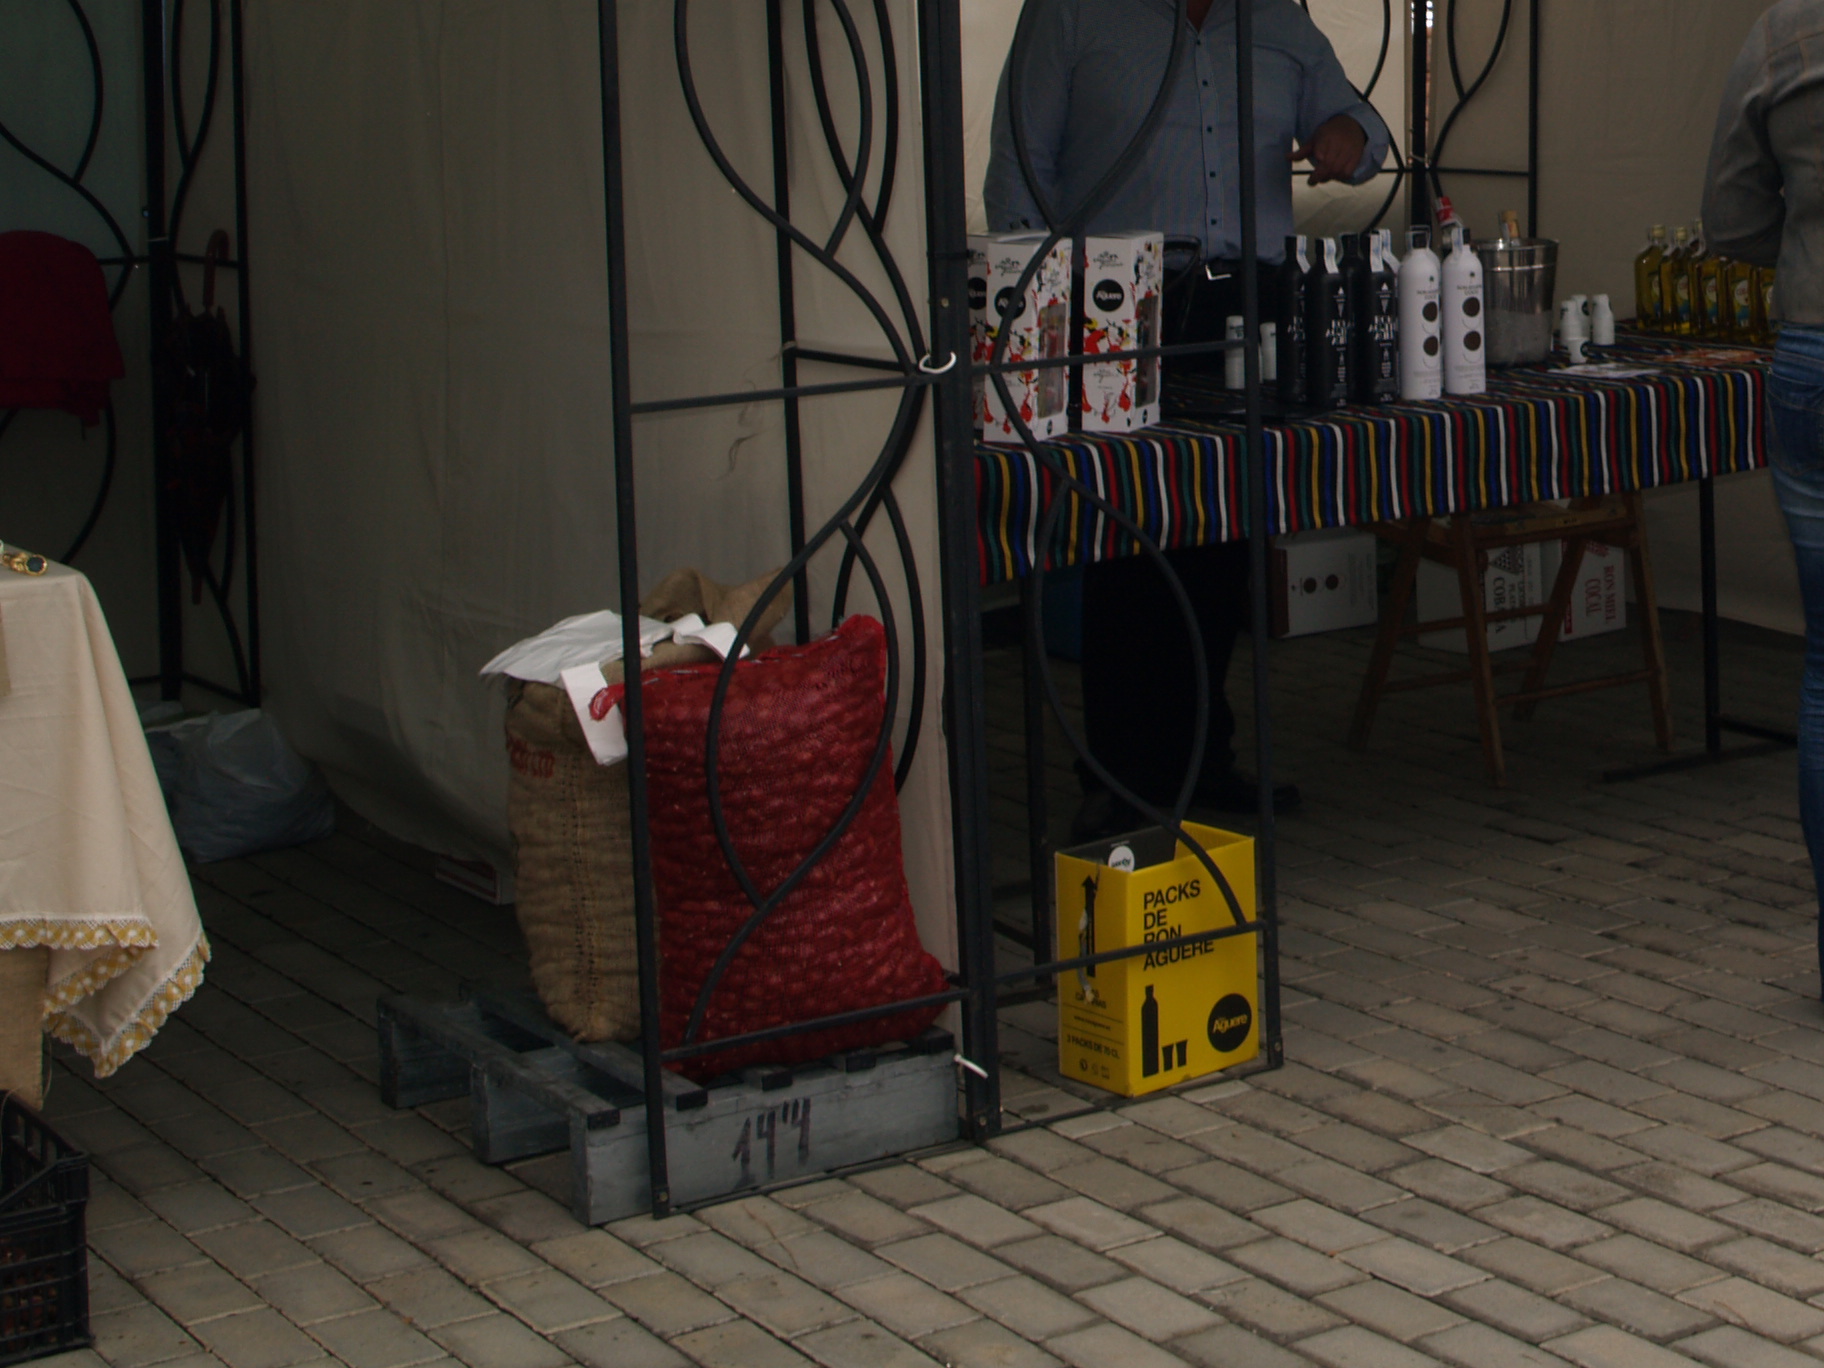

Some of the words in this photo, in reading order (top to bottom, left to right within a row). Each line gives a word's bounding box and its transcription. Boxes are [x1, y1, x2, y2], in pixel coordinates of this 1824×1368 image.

[1144, 879, 1201, 910] PACKS
[1144, 908, 1167, 930] DE
[1143, 940, 1215, 972] AGUERE
[1211, 1014, 1248, 1035] Aguere
